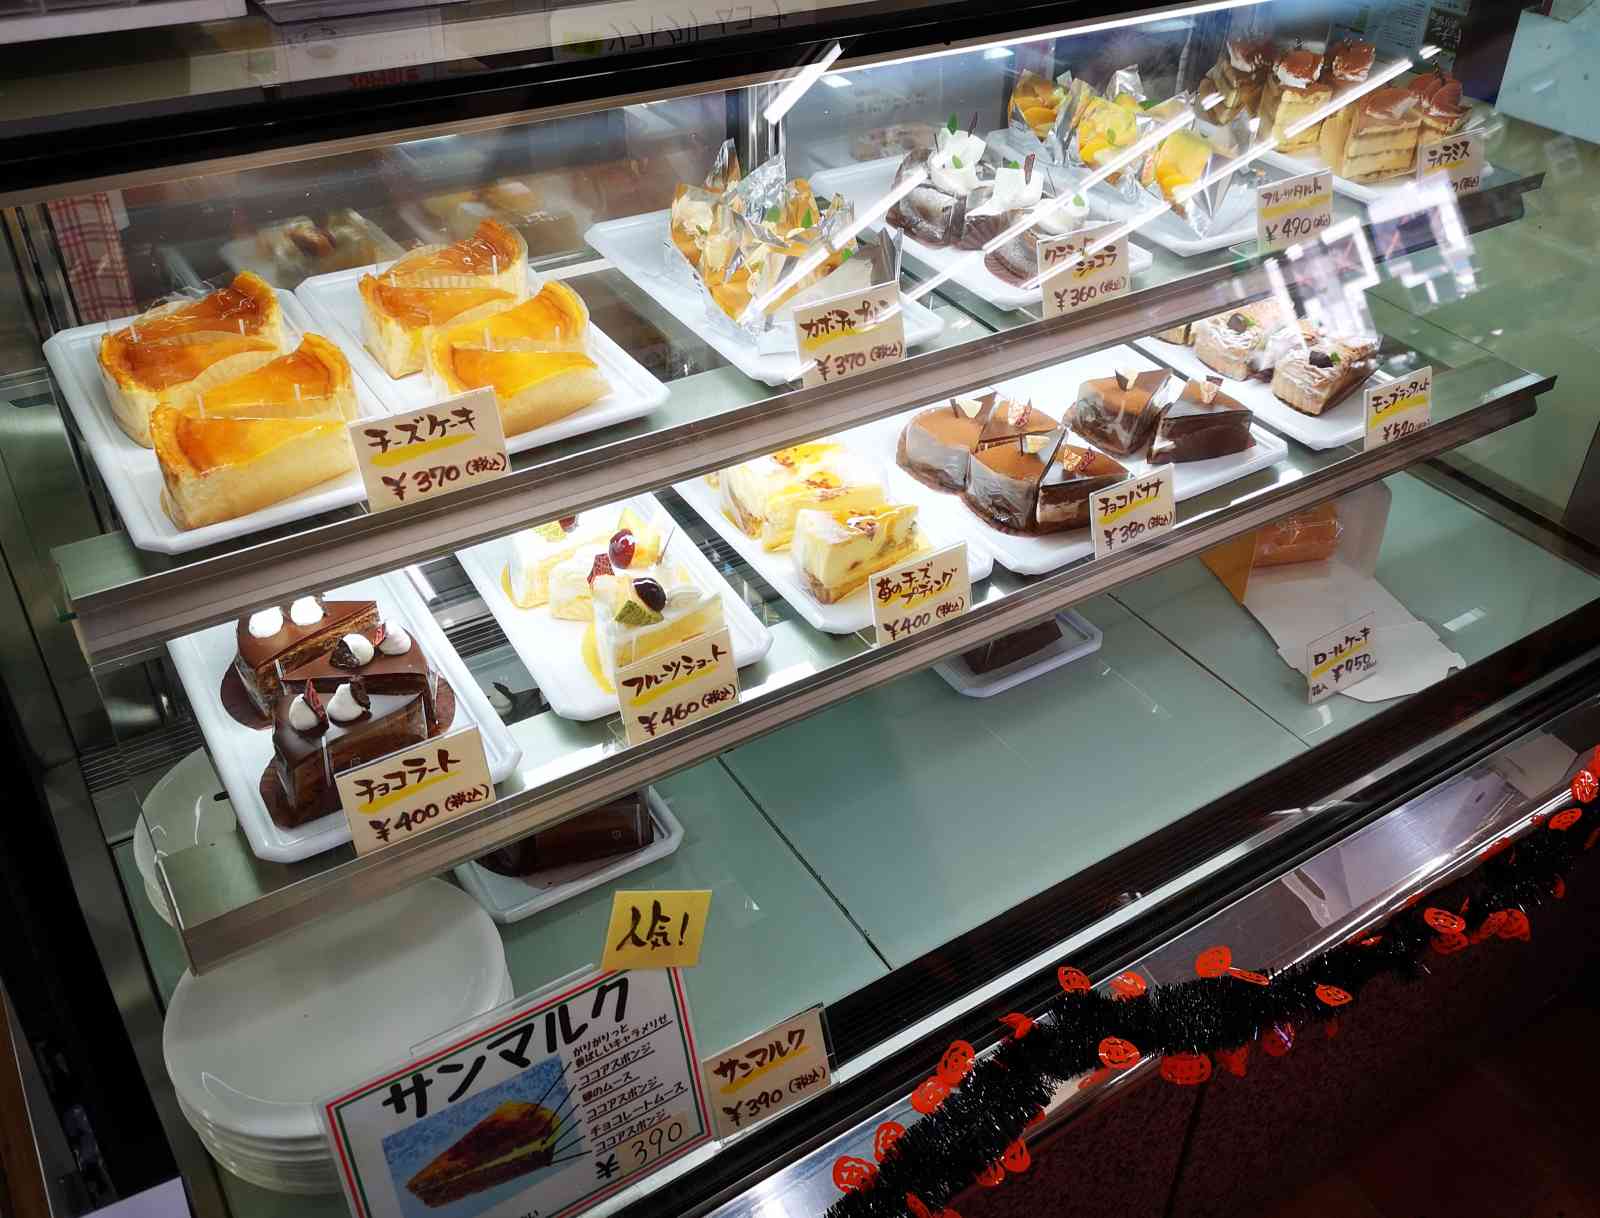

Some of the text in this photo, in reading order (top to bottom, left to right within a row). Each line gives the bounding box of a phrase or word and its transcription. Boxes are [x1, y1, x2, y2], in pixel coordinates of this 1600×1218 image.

[1427, 141, 1470, 168] ティラミス
[364, 407, 476, 454] チーズケーキ
[1098, 478, 1163, 516] チョコバナナ
[1313, 626, 1371, 665] ロールケーキ
[622, 644, 727, 696] フルーツショート
[353, 749, 461, 804] チョコラート
[382, 977, 629, 1118] サンマルク
[579, 1042, 652, 1084] ココアスポンジ
[713, 1029, 806, 1084] サンマルク
[586, 1076, 659, 1120] ココアスポンジ
[590, 1081, 685, 1137] チョコレートムース
